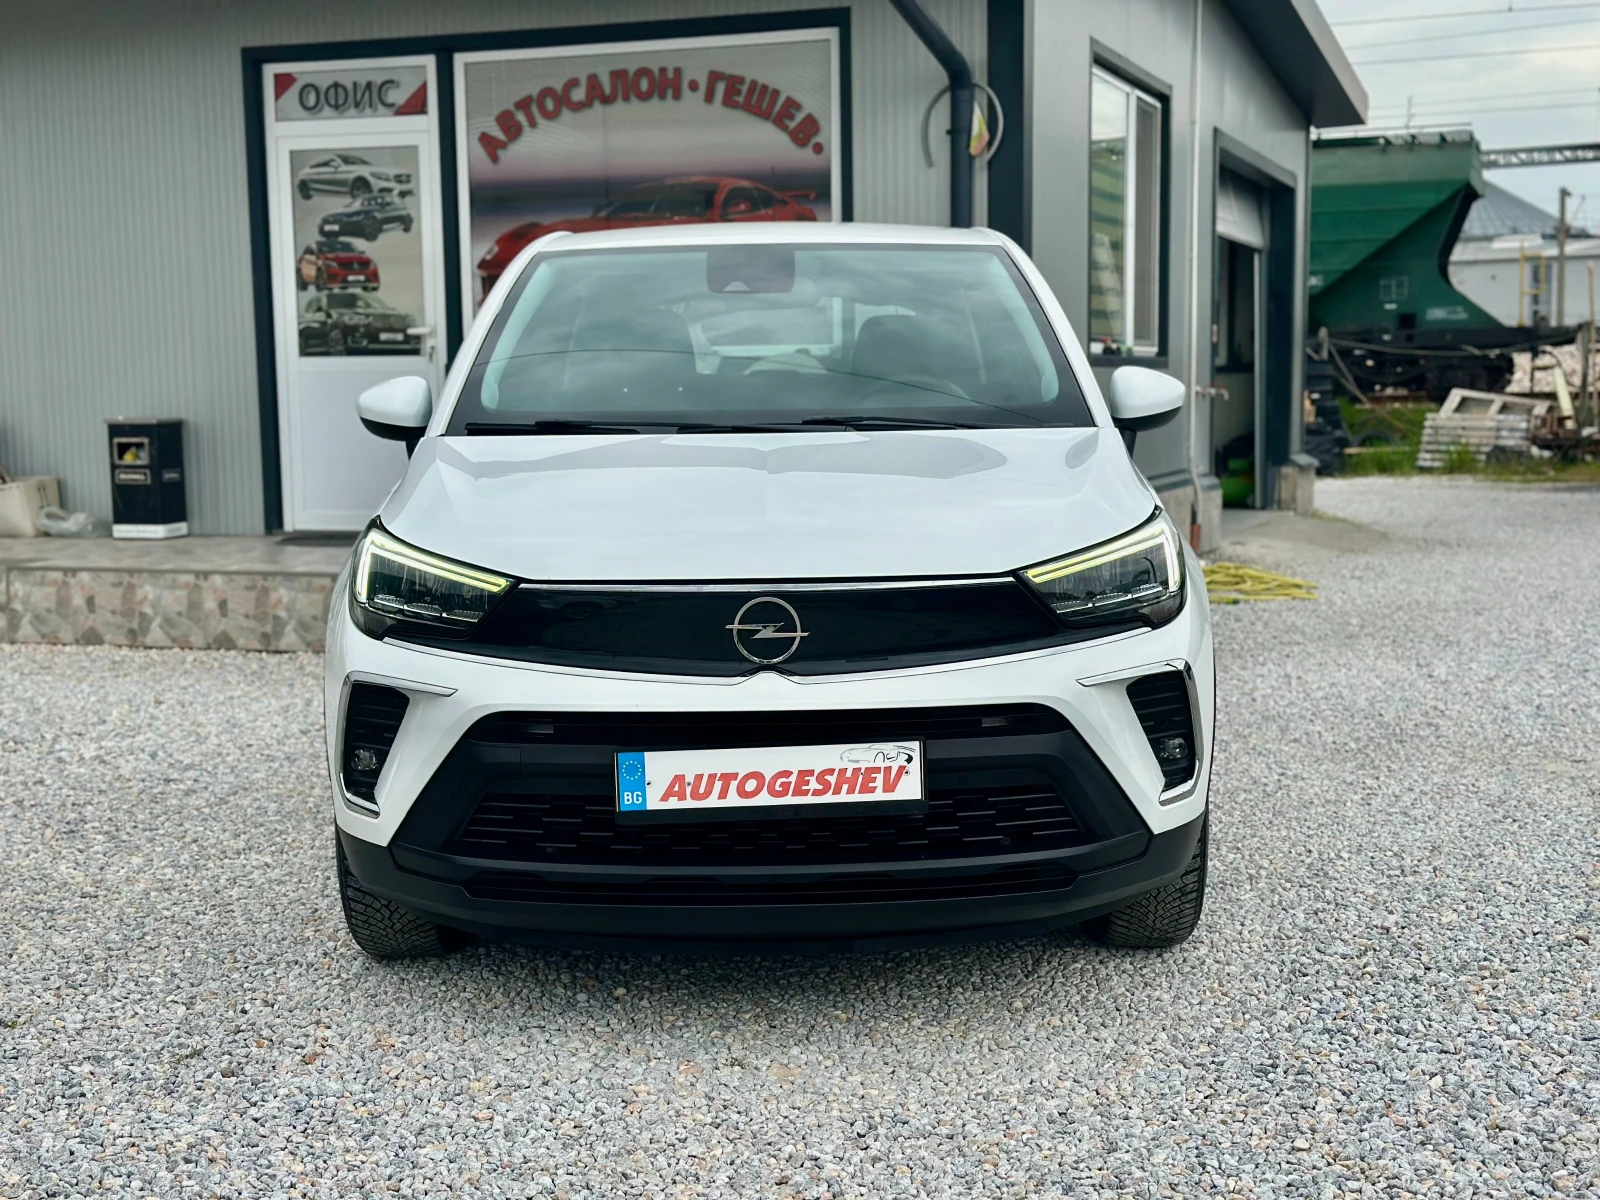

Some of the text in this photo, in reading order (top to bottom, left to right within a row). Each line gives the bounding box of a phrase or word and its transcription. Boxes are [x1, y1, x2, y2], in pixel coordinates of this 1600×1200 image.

[298, 79, 398, 112] ОФИС
[478, 66, 682, 164] АВТОСАЛОН
[623, 765, 907, 805] BG AUTOGESHEV
